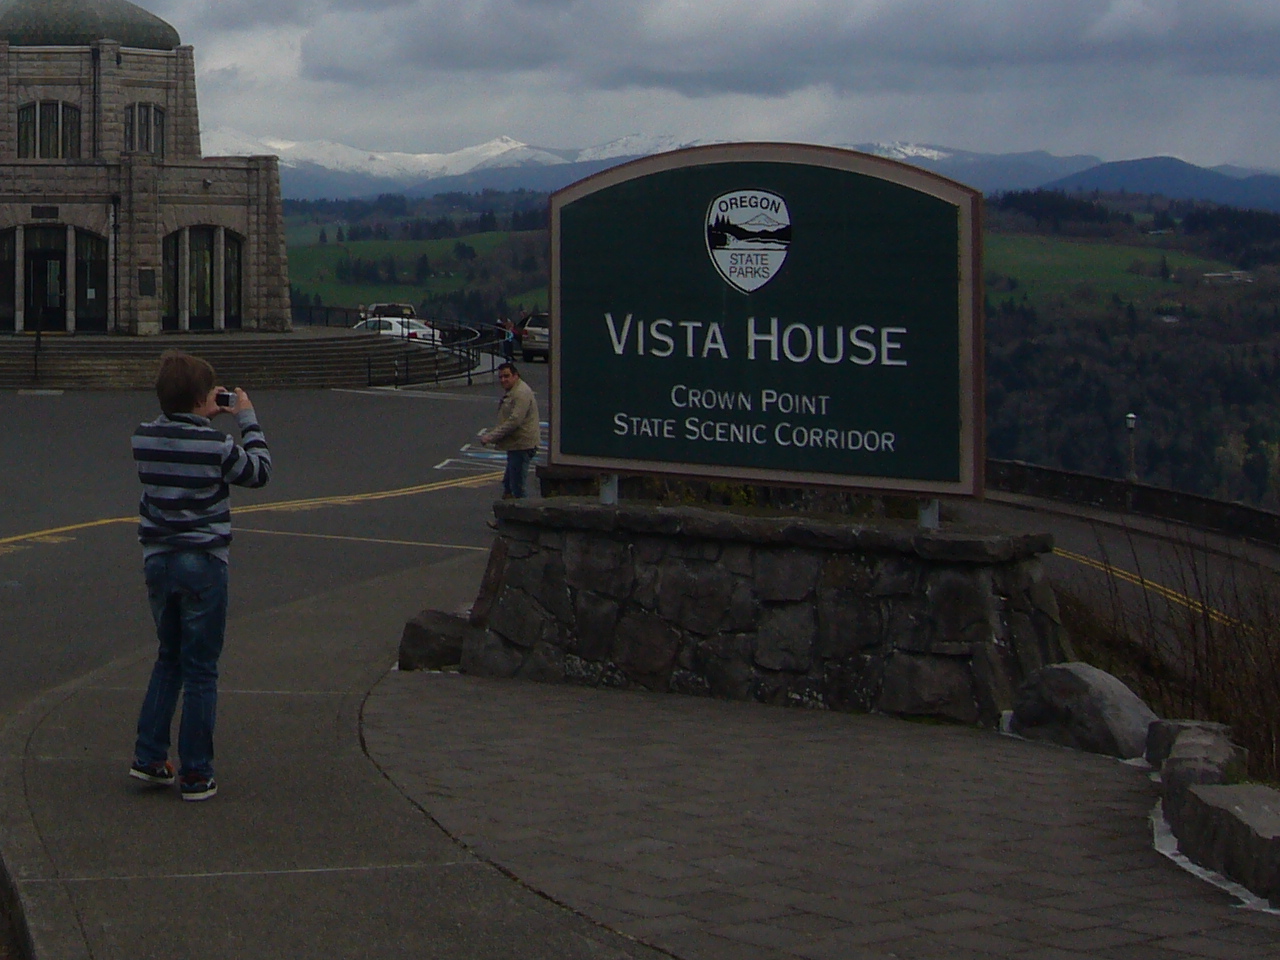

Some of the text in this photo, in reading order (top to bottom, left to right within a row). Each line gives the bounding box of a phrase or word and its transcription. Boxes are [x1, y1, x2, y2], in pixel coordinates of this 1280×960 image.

[719, 196, 780, 214] OREGON
[730, 253, 769, 265] STATE
[729, 266, 770, 279] PARKS
[604, 312, 908, 367] VISTA HOUSE
[670, 384, 830, 415] CROWN POINT
[613, 413, 896, 452] STATE SCENIC CORRIDOR
